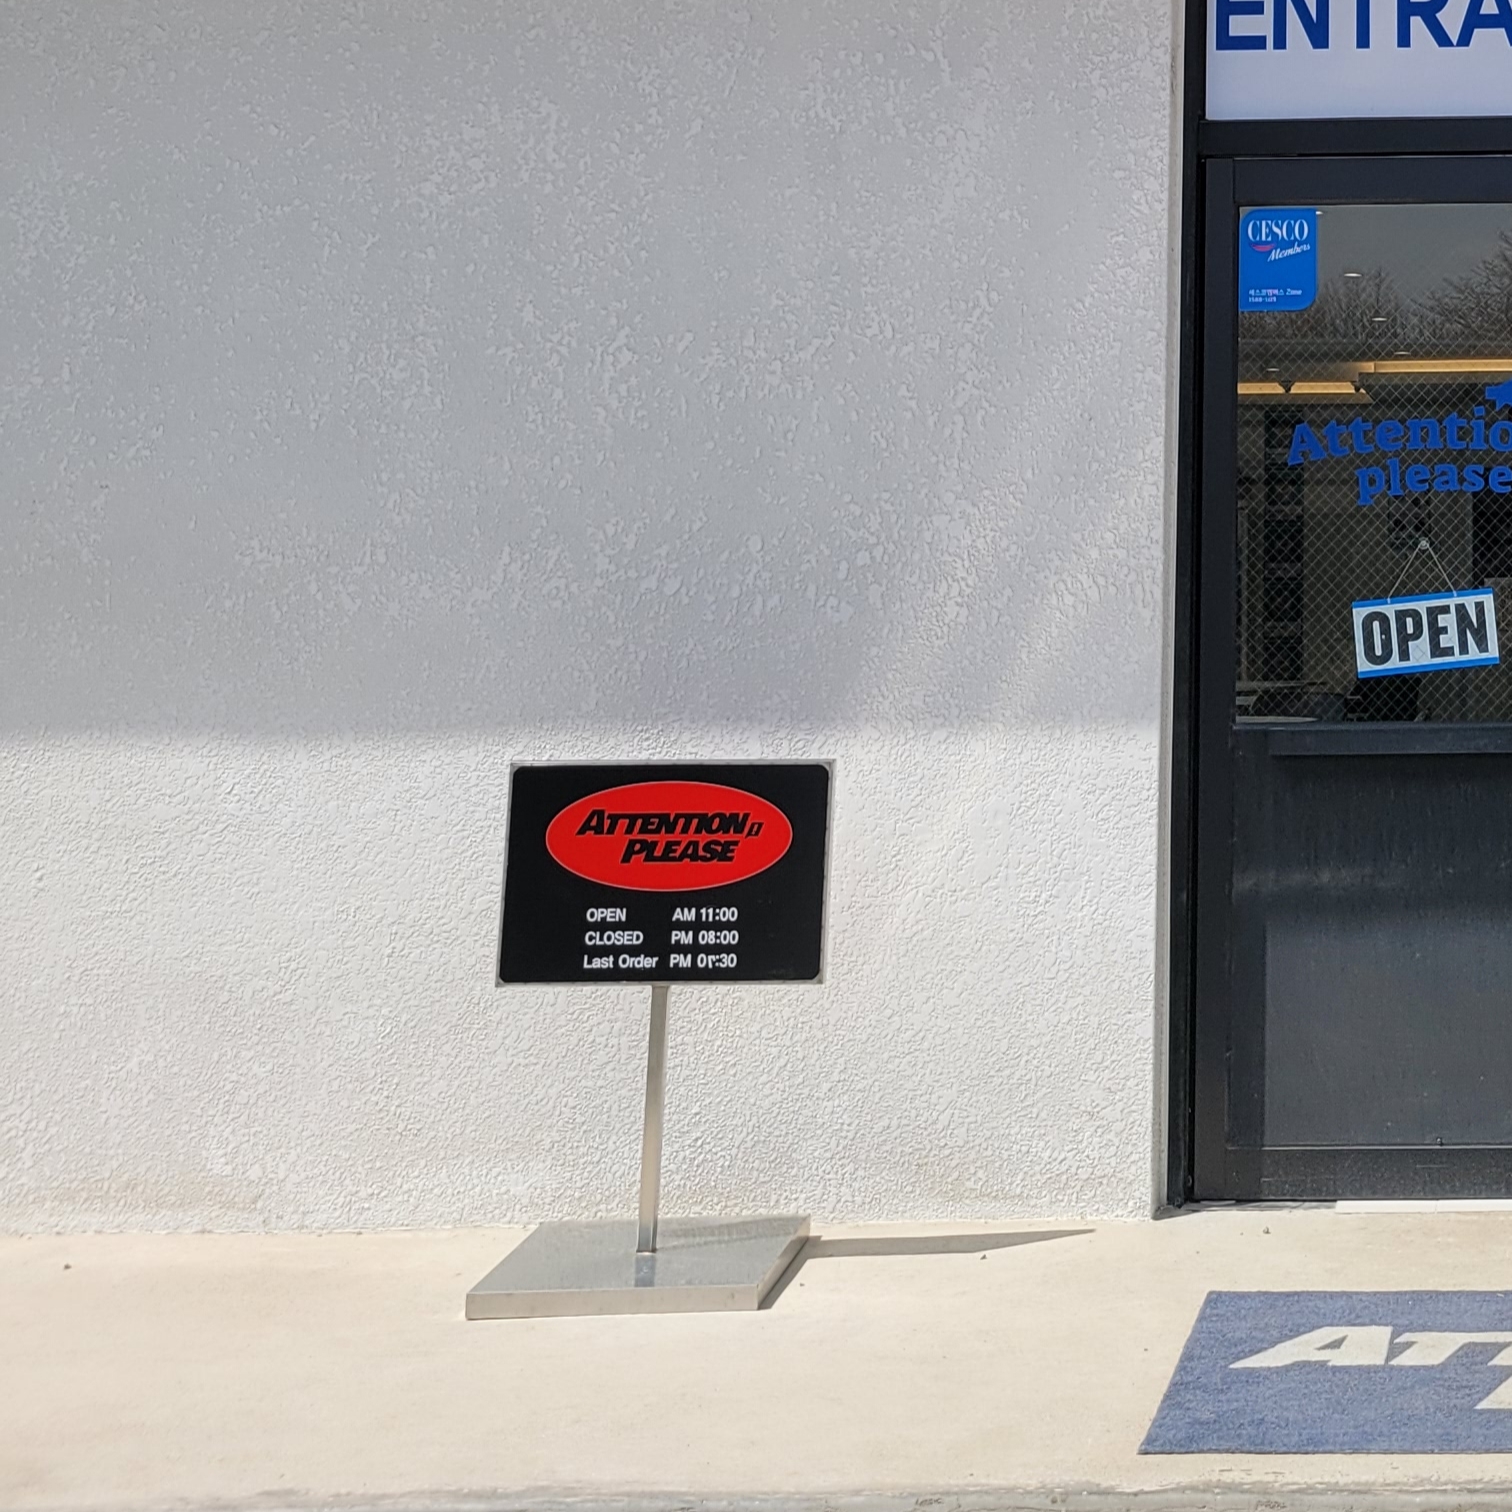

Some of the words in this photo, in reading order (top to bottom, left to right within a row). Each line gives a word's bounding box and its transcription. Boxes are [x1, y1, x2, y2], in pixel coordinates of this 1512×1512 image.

[1247, 219, 1309, 241] CESCO
[1267, 242, 1311, 262] Members
[1362, 601, 1489, 667] OPEN
[620, 838, 740, 864] PLEASE
[586, 907, 627, 922] OPEN
[671, 907, 696, 922] AM
[699, 906, 739, 922] 11:00
[584, 930, 644, 945] CLOSED
[671, 930, 694, 945] PM
[698, 930, 739, 945] 08:00
[583, 954, 615, 969] Last
[618, 954, 659, 969] Order
[669, 953, 692, 968] PM
